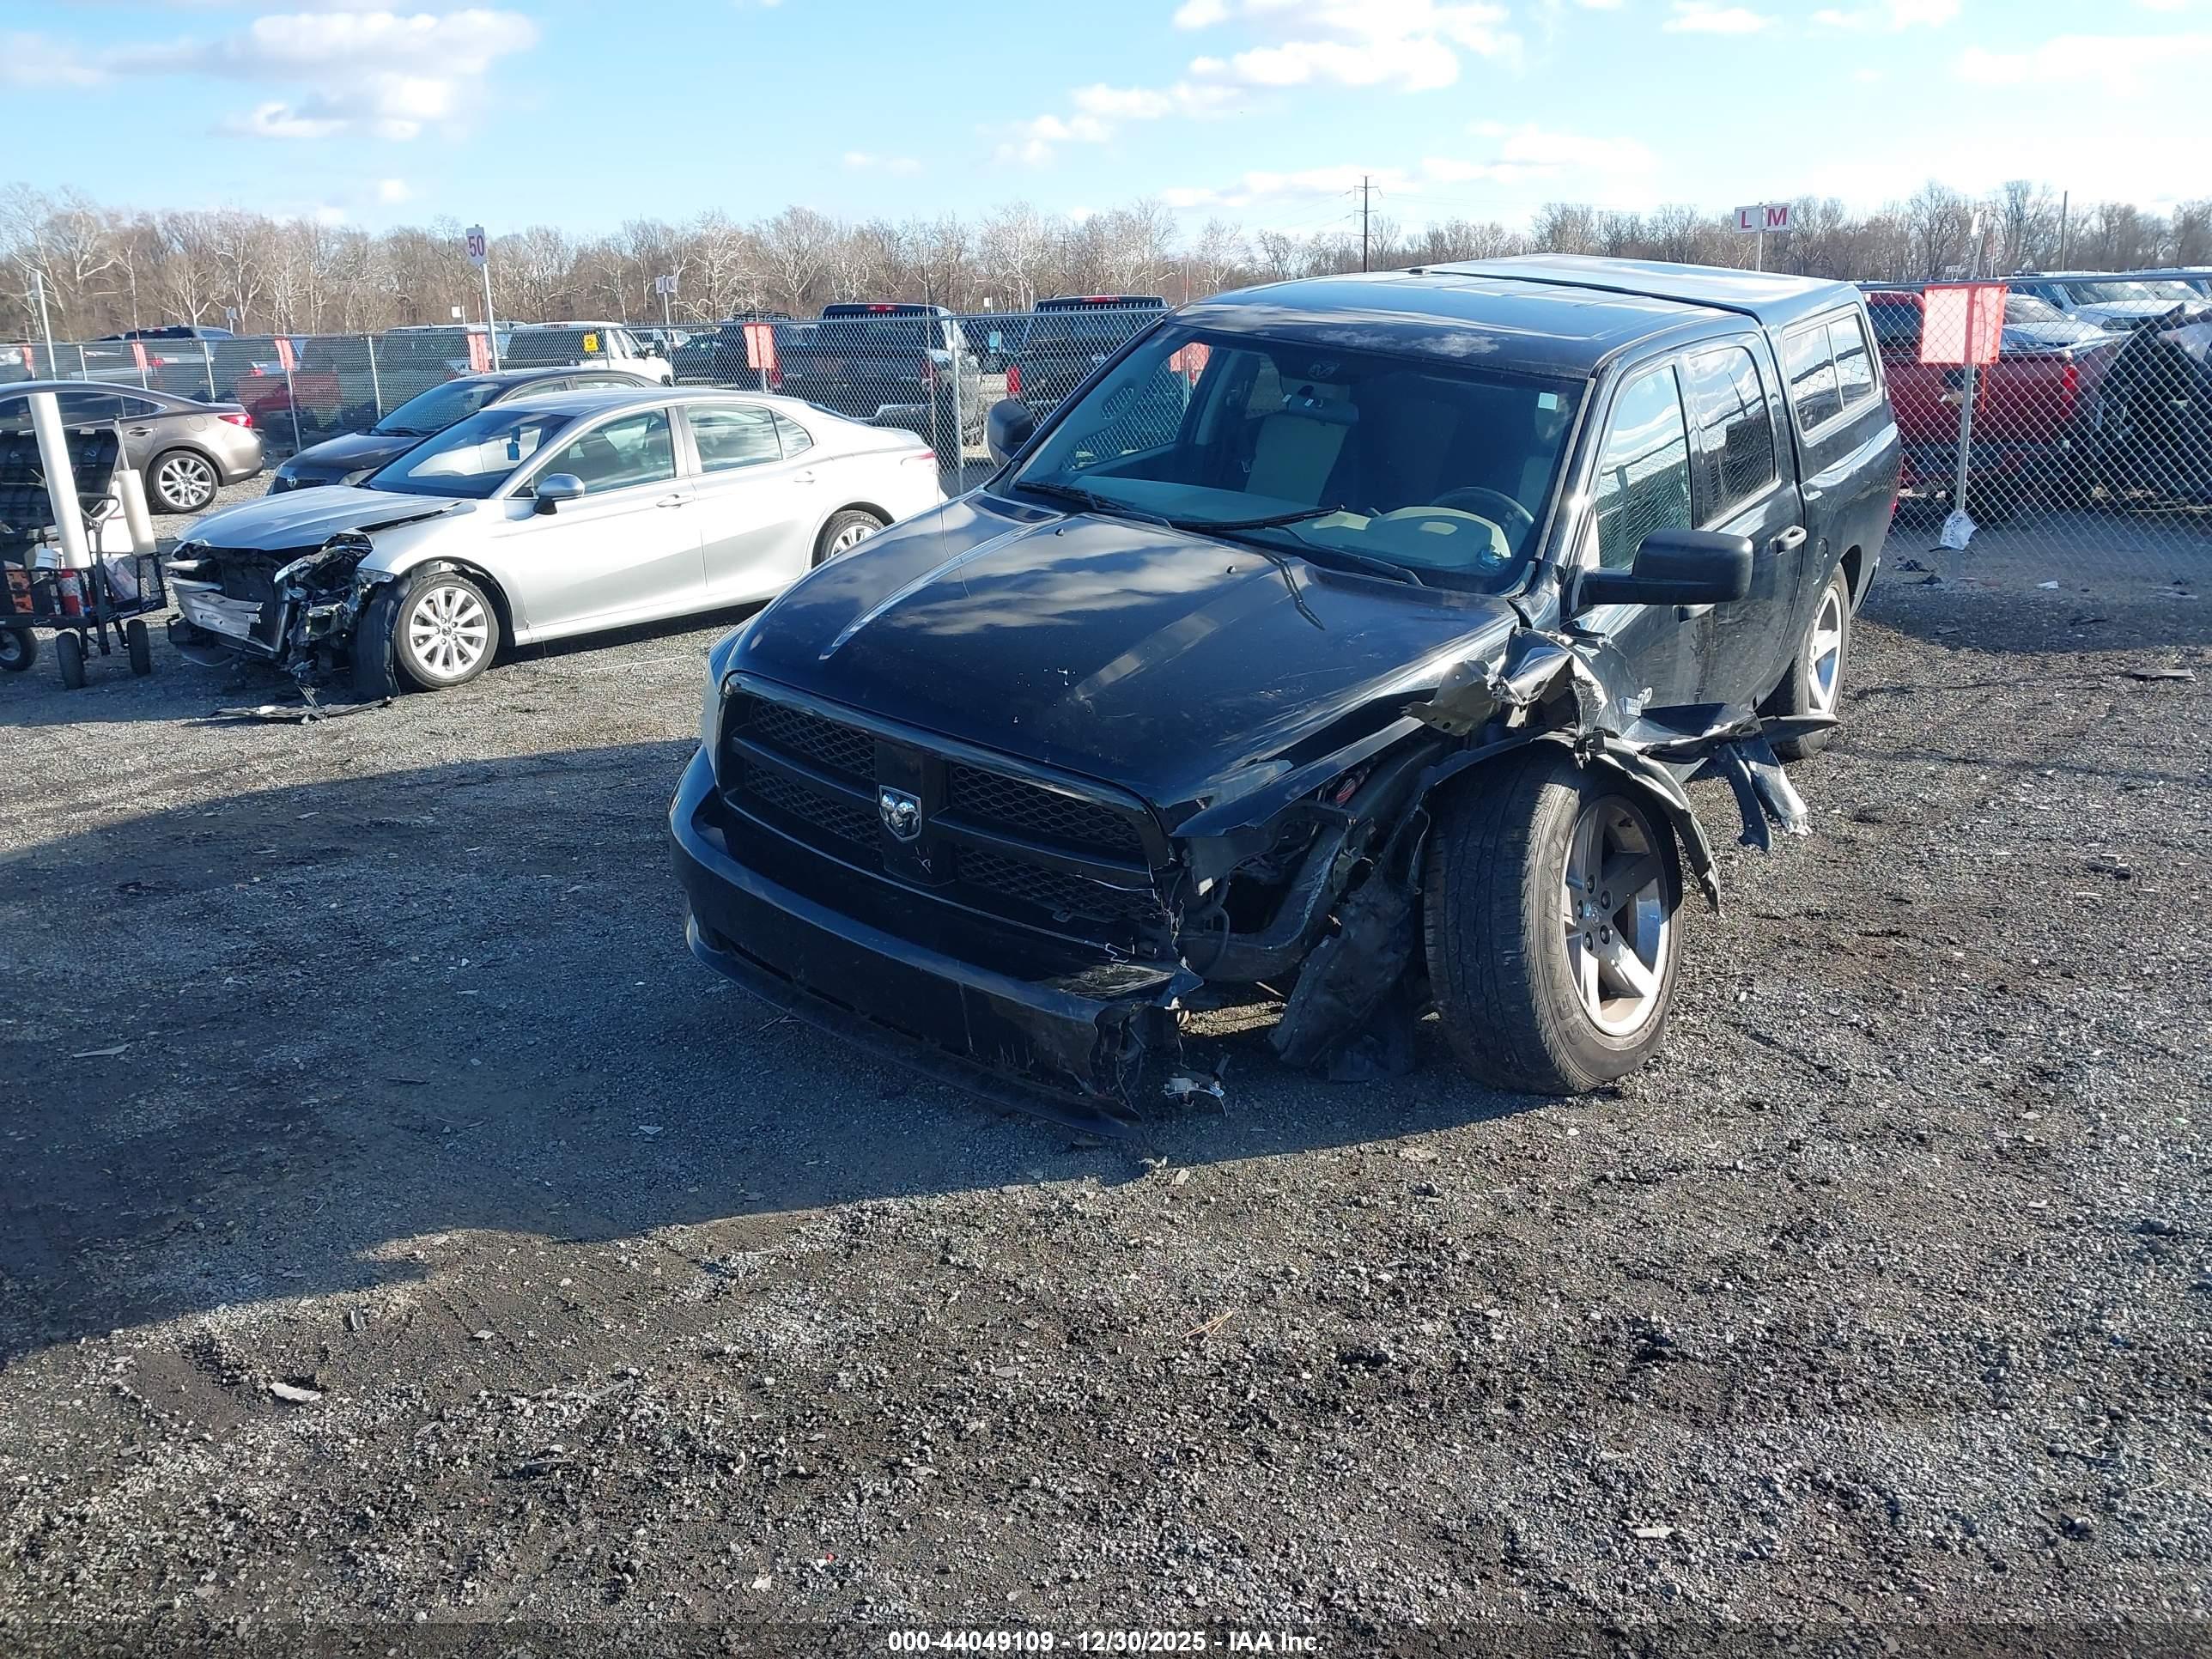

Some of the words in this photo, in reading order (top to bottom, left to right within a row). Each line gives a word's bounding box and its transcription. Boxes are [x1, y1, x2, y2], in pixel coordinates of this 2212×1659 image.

[1741, 210, 1752, 228] L
[1767, 208, 1787, 226] M
[468, 234, 484, 257] 50
[667, 278, 674, 289] K
